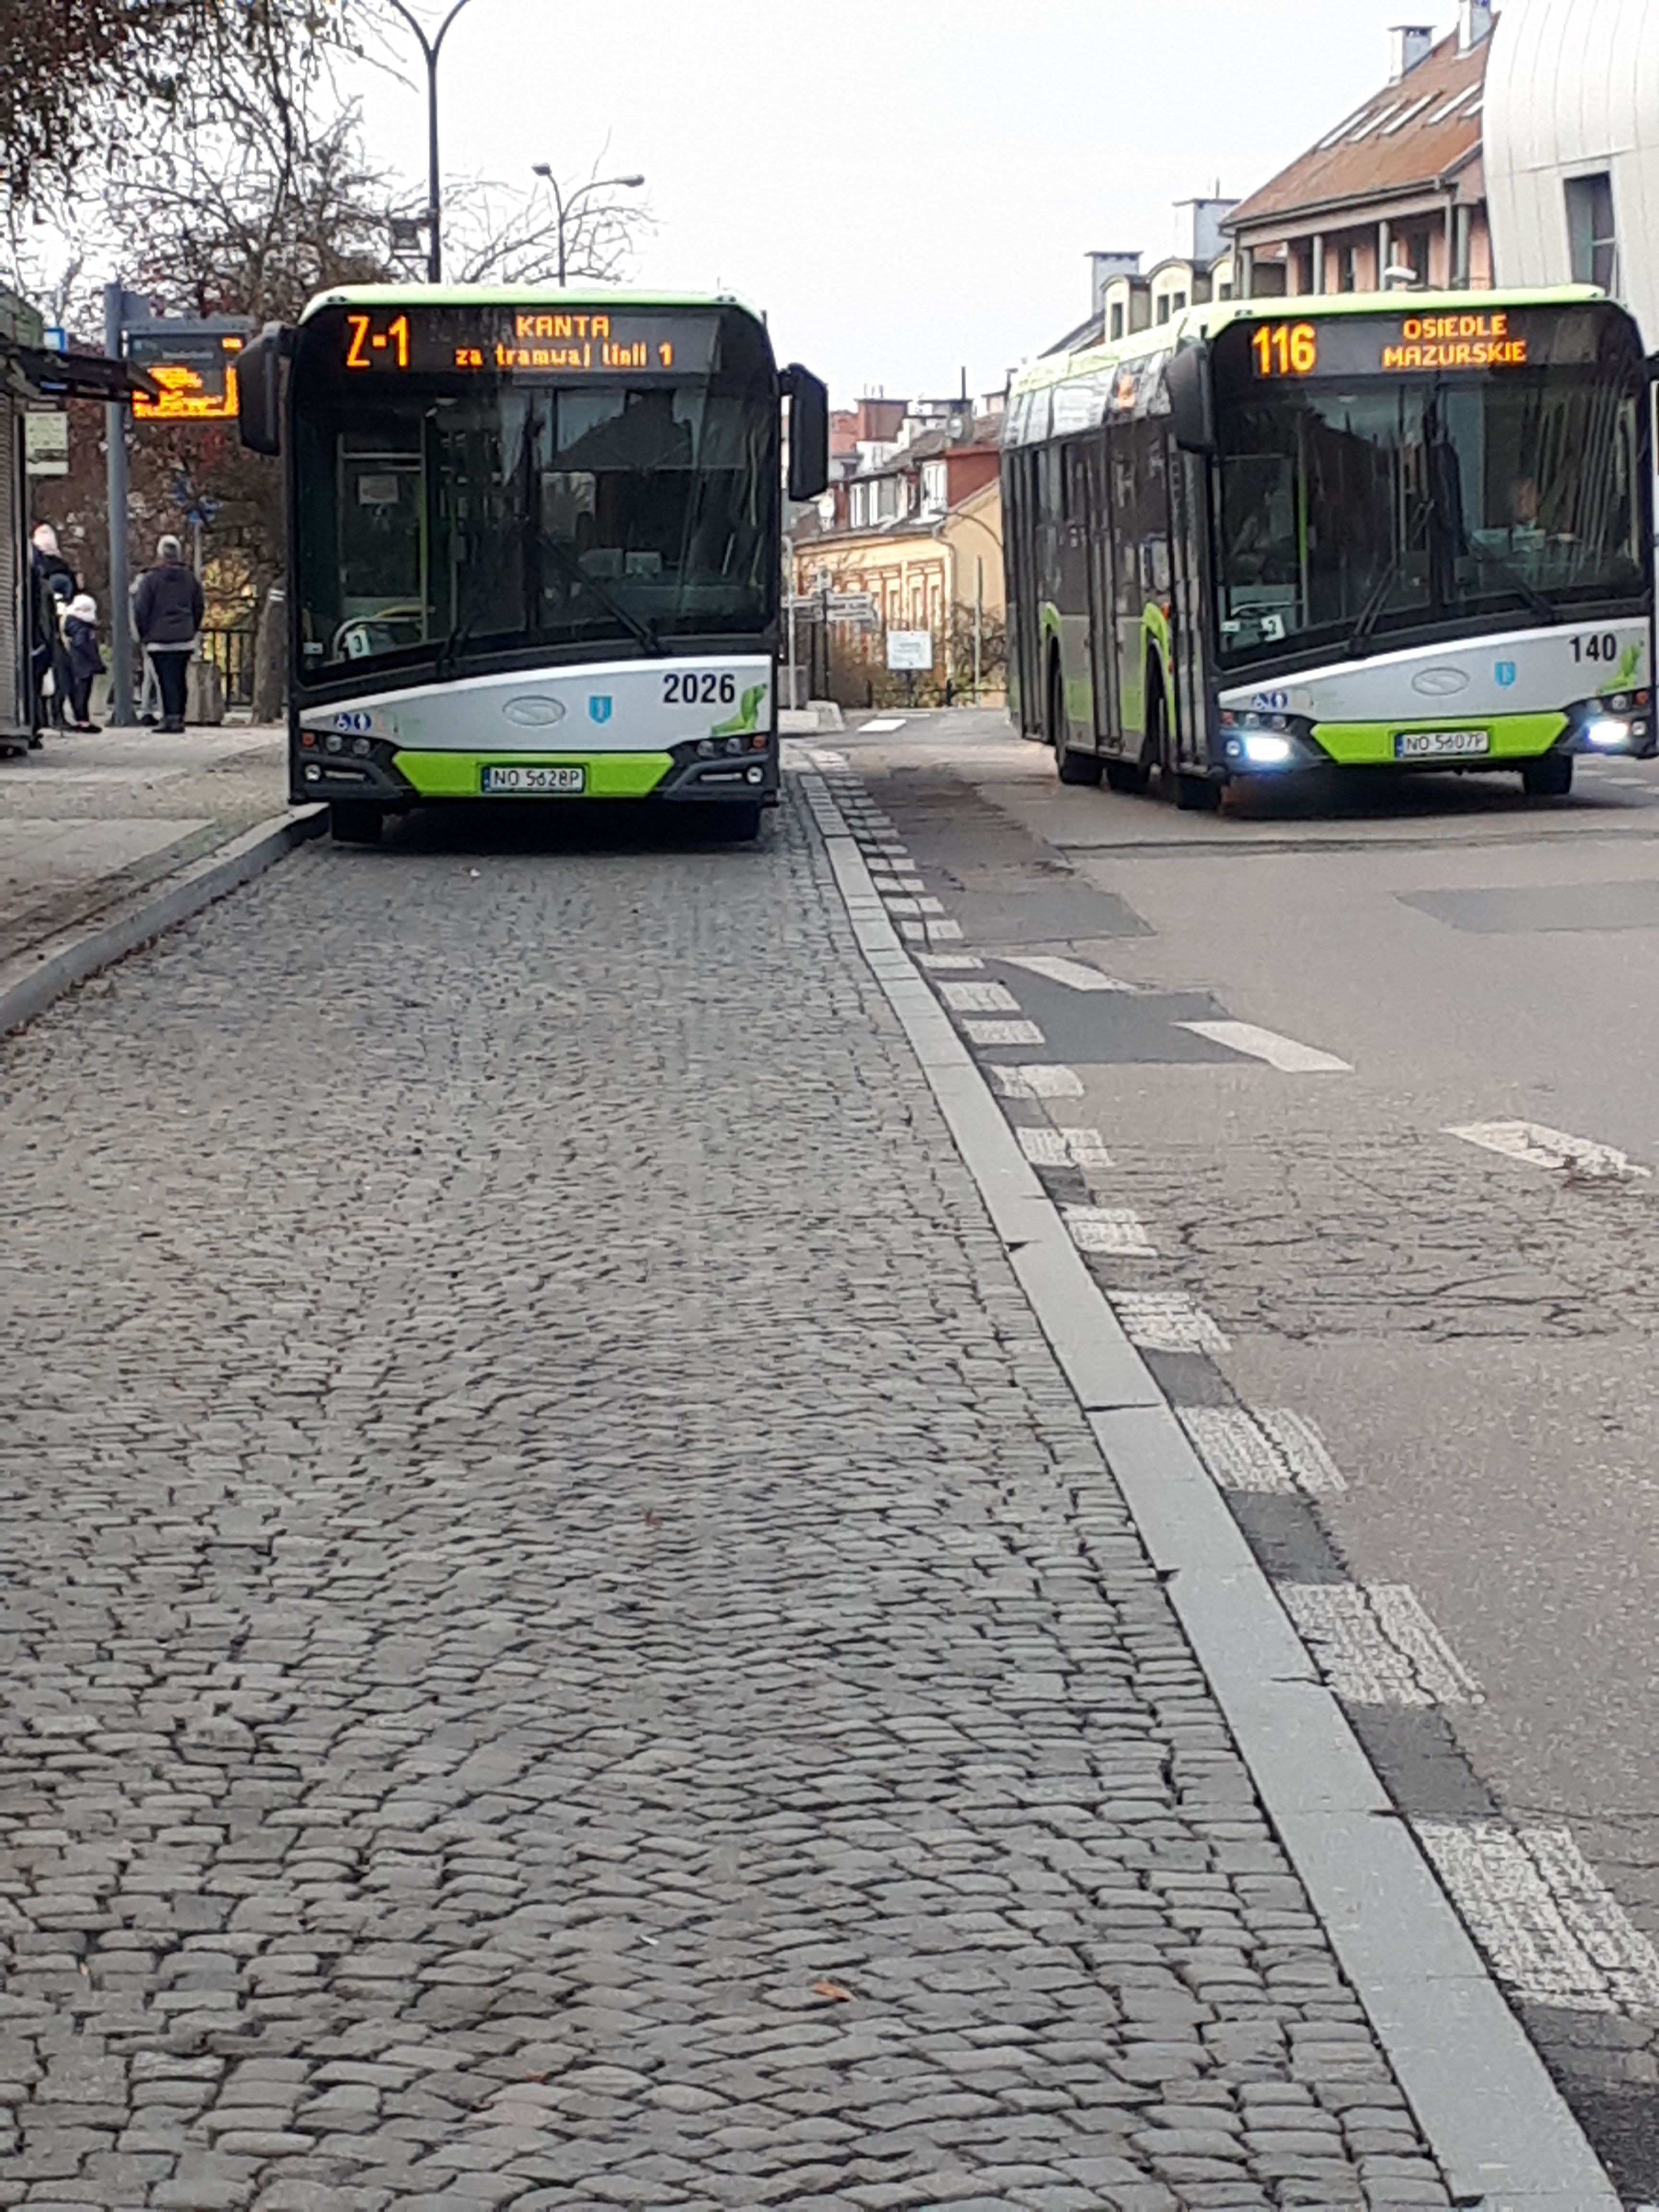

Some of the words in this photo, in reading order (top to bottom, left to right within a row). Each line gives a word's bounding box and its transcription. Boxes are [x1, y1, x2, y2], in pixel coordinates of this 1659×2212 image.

[516, 315, 610, 337] KANTA
[1403, 314, 1507, 339] OSIEDLE
[346, 315, 409, 367] Z-1
[455, 348, 482, 365] za
[496, 343, 590, 368] tramwaj
[659, 342, 671, 366] 1
[1252, 323, 1315, 375] 116
[1383, 339, 1526, 367] MAZURSKIE
[1569, 633, 1617, 663] 140
[663, 673, 735, 704] 2026
[494, 770, 519, 786] NO
